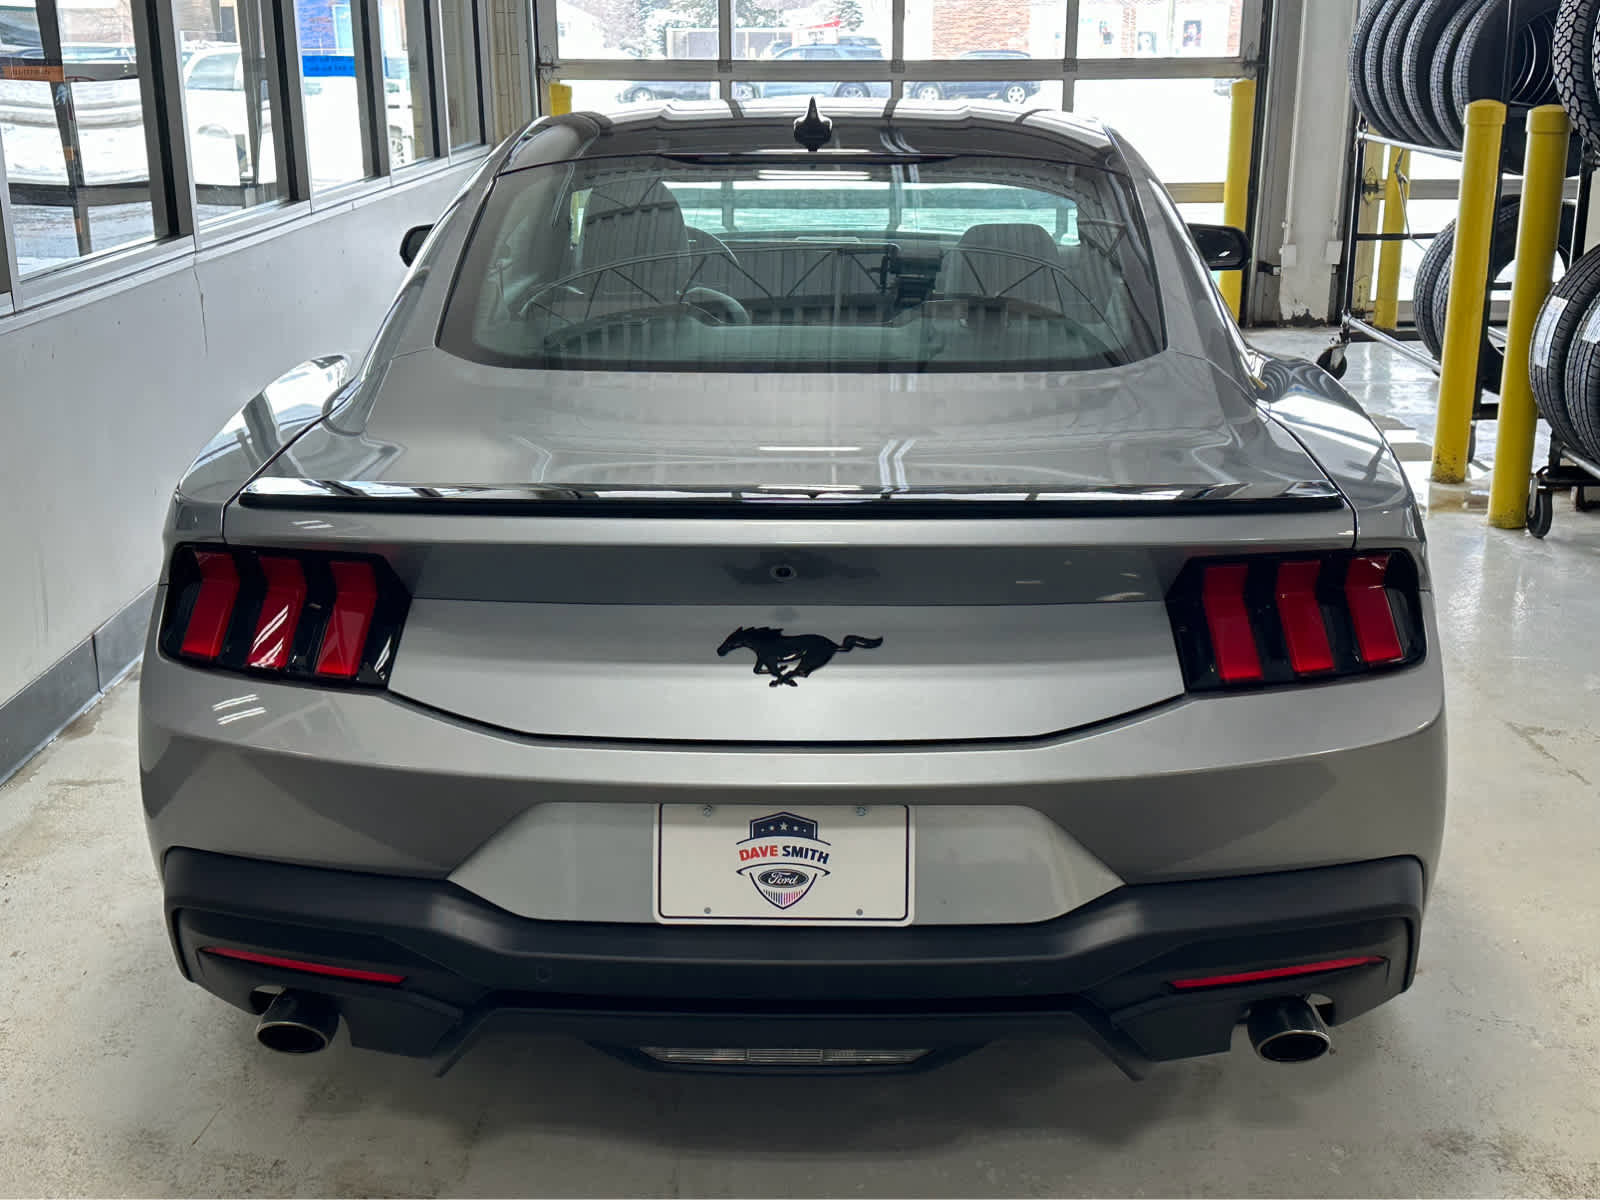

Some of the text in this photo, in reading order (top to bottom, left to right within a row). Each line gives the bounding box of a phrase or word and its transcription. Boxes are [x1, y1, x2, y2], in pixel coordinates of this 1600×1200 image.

[739, 845, 829, 864] DAVE SMITH
[767, 871, 799, 885] Ford
